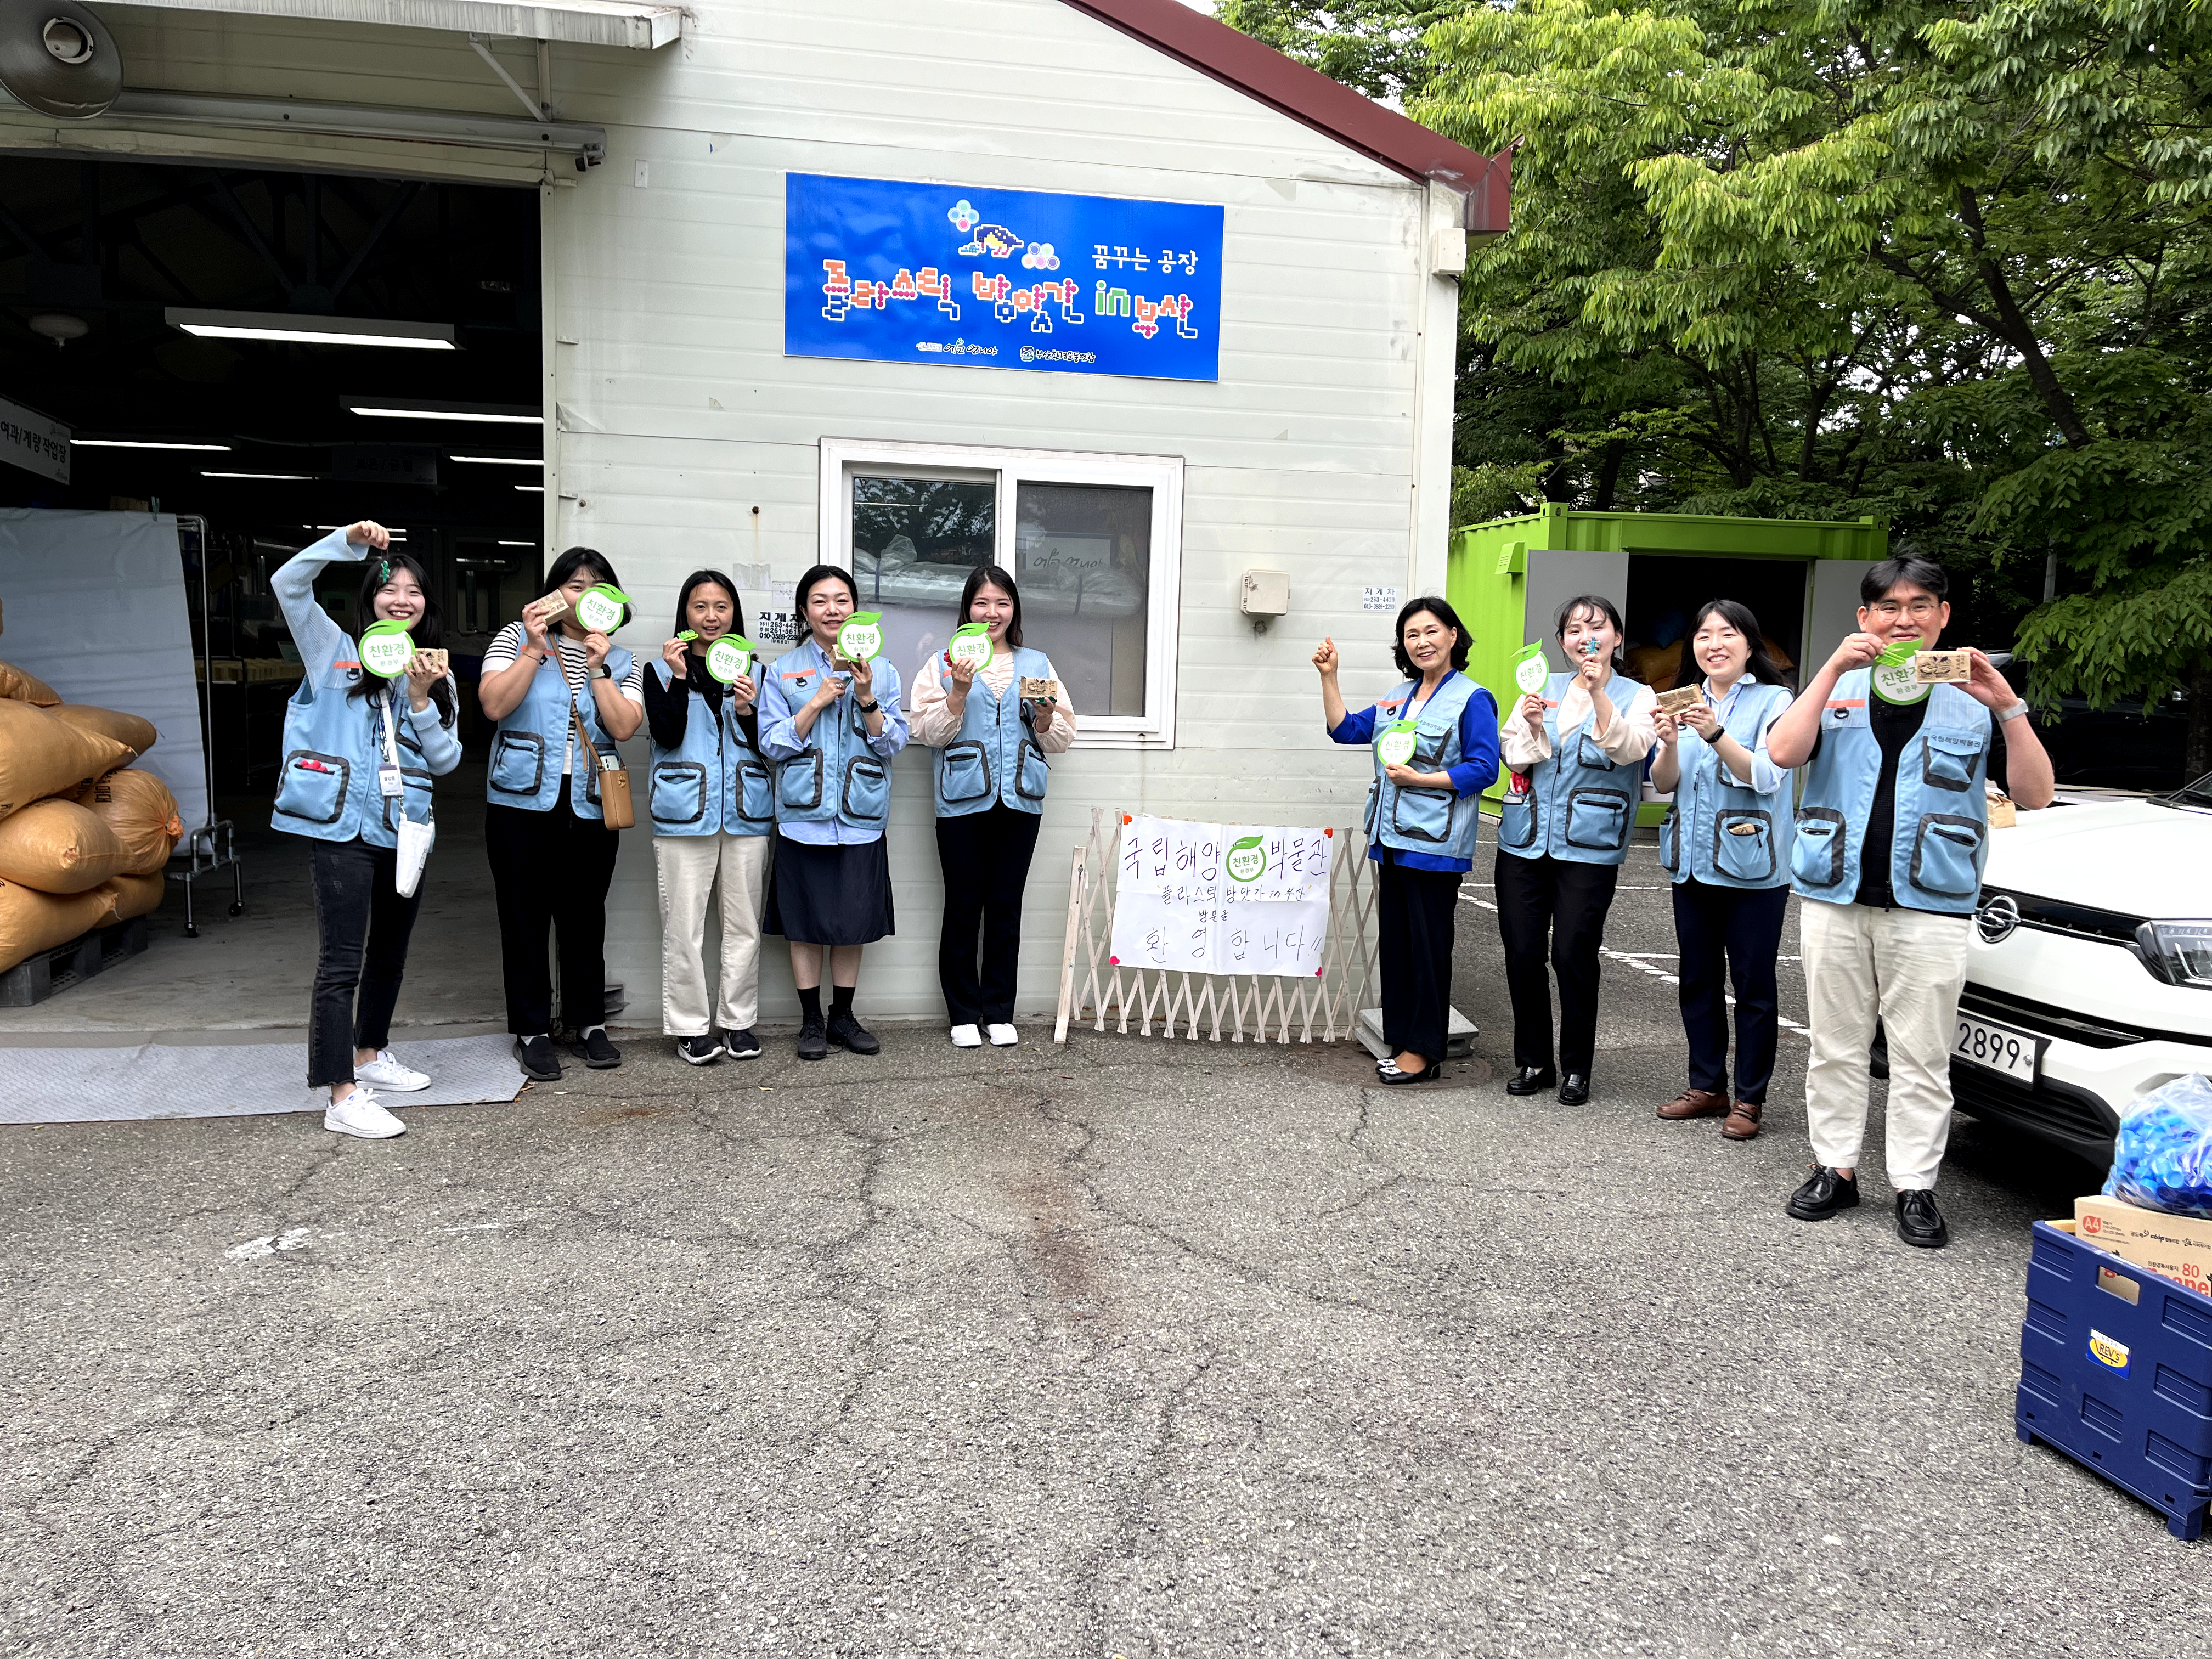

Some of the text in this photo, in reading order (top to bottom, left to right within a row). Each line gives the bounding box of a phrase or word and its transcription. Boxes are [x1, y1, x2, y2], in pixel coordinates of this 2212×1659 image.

[1092, 245, 1199, 275] 꿈꾸는 공장
[822, 259, 960, 321] 플라스틱
[973, 271, 1084, 332] 방앗간
[43, 437, 66, 463] 작업장
[586, 599, 616, 620] 친환경
[846, 633, 875, 644] 친환경
[369, 642, 405, 658] 친환경
[957, 642, 985, 656] 친환경
[715, 650, 743, 669] 친환경
[1520, 662, 1542, 681] 친환경
[1897, 684, 1918, 694] 환경부
[1385, 740, 1409, 751] 친환경
[1233, 854, 1259, 867] 친환경
[1269, 837, 1327, 880] 박물관
[1226, 884, 1265, 904] 방앗간
[1199, 910, 1229, 923] 방문을
[1958, 1022, 2020, 1069] 2899
[2084, 1217, 2101, 1231] A4
[2182, 1263, 2199, 1278] 80
